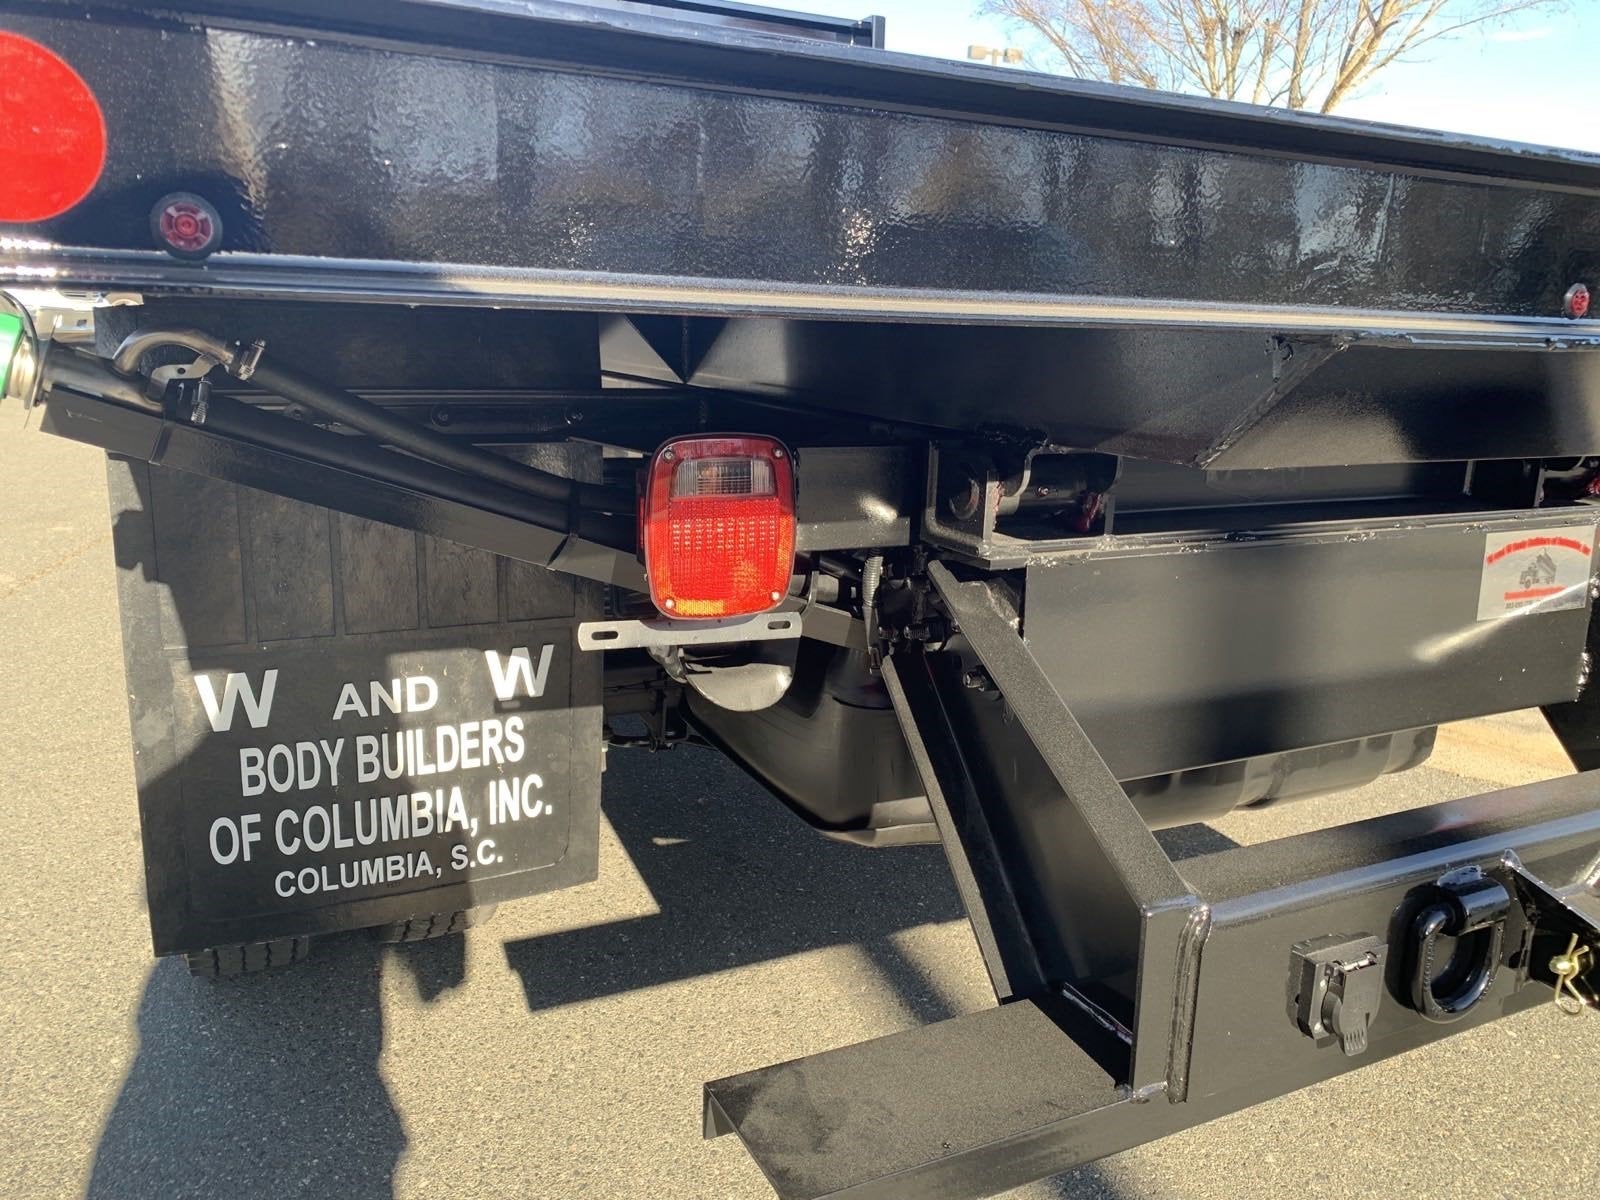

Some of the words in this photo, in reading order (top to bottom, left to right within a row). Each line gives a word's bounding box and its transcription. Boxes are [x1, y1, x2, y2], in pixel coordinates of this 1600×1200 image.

[193, 668, 279, 732] W
[332, 675, 439, 721] AND
[484, 644, 555, 699] W
[239, 737, 345, 797] BODY
[355, 716, 526, 784] BUILDERS
[208, 813, 262, 866] OF
[274, 786, 479, 856] COLUMBIA,
[488, 774, 553, 826] INC.
[274, 850, 442, 896] COLUMBIA,
[450, 840, 504, 872] S.C.
